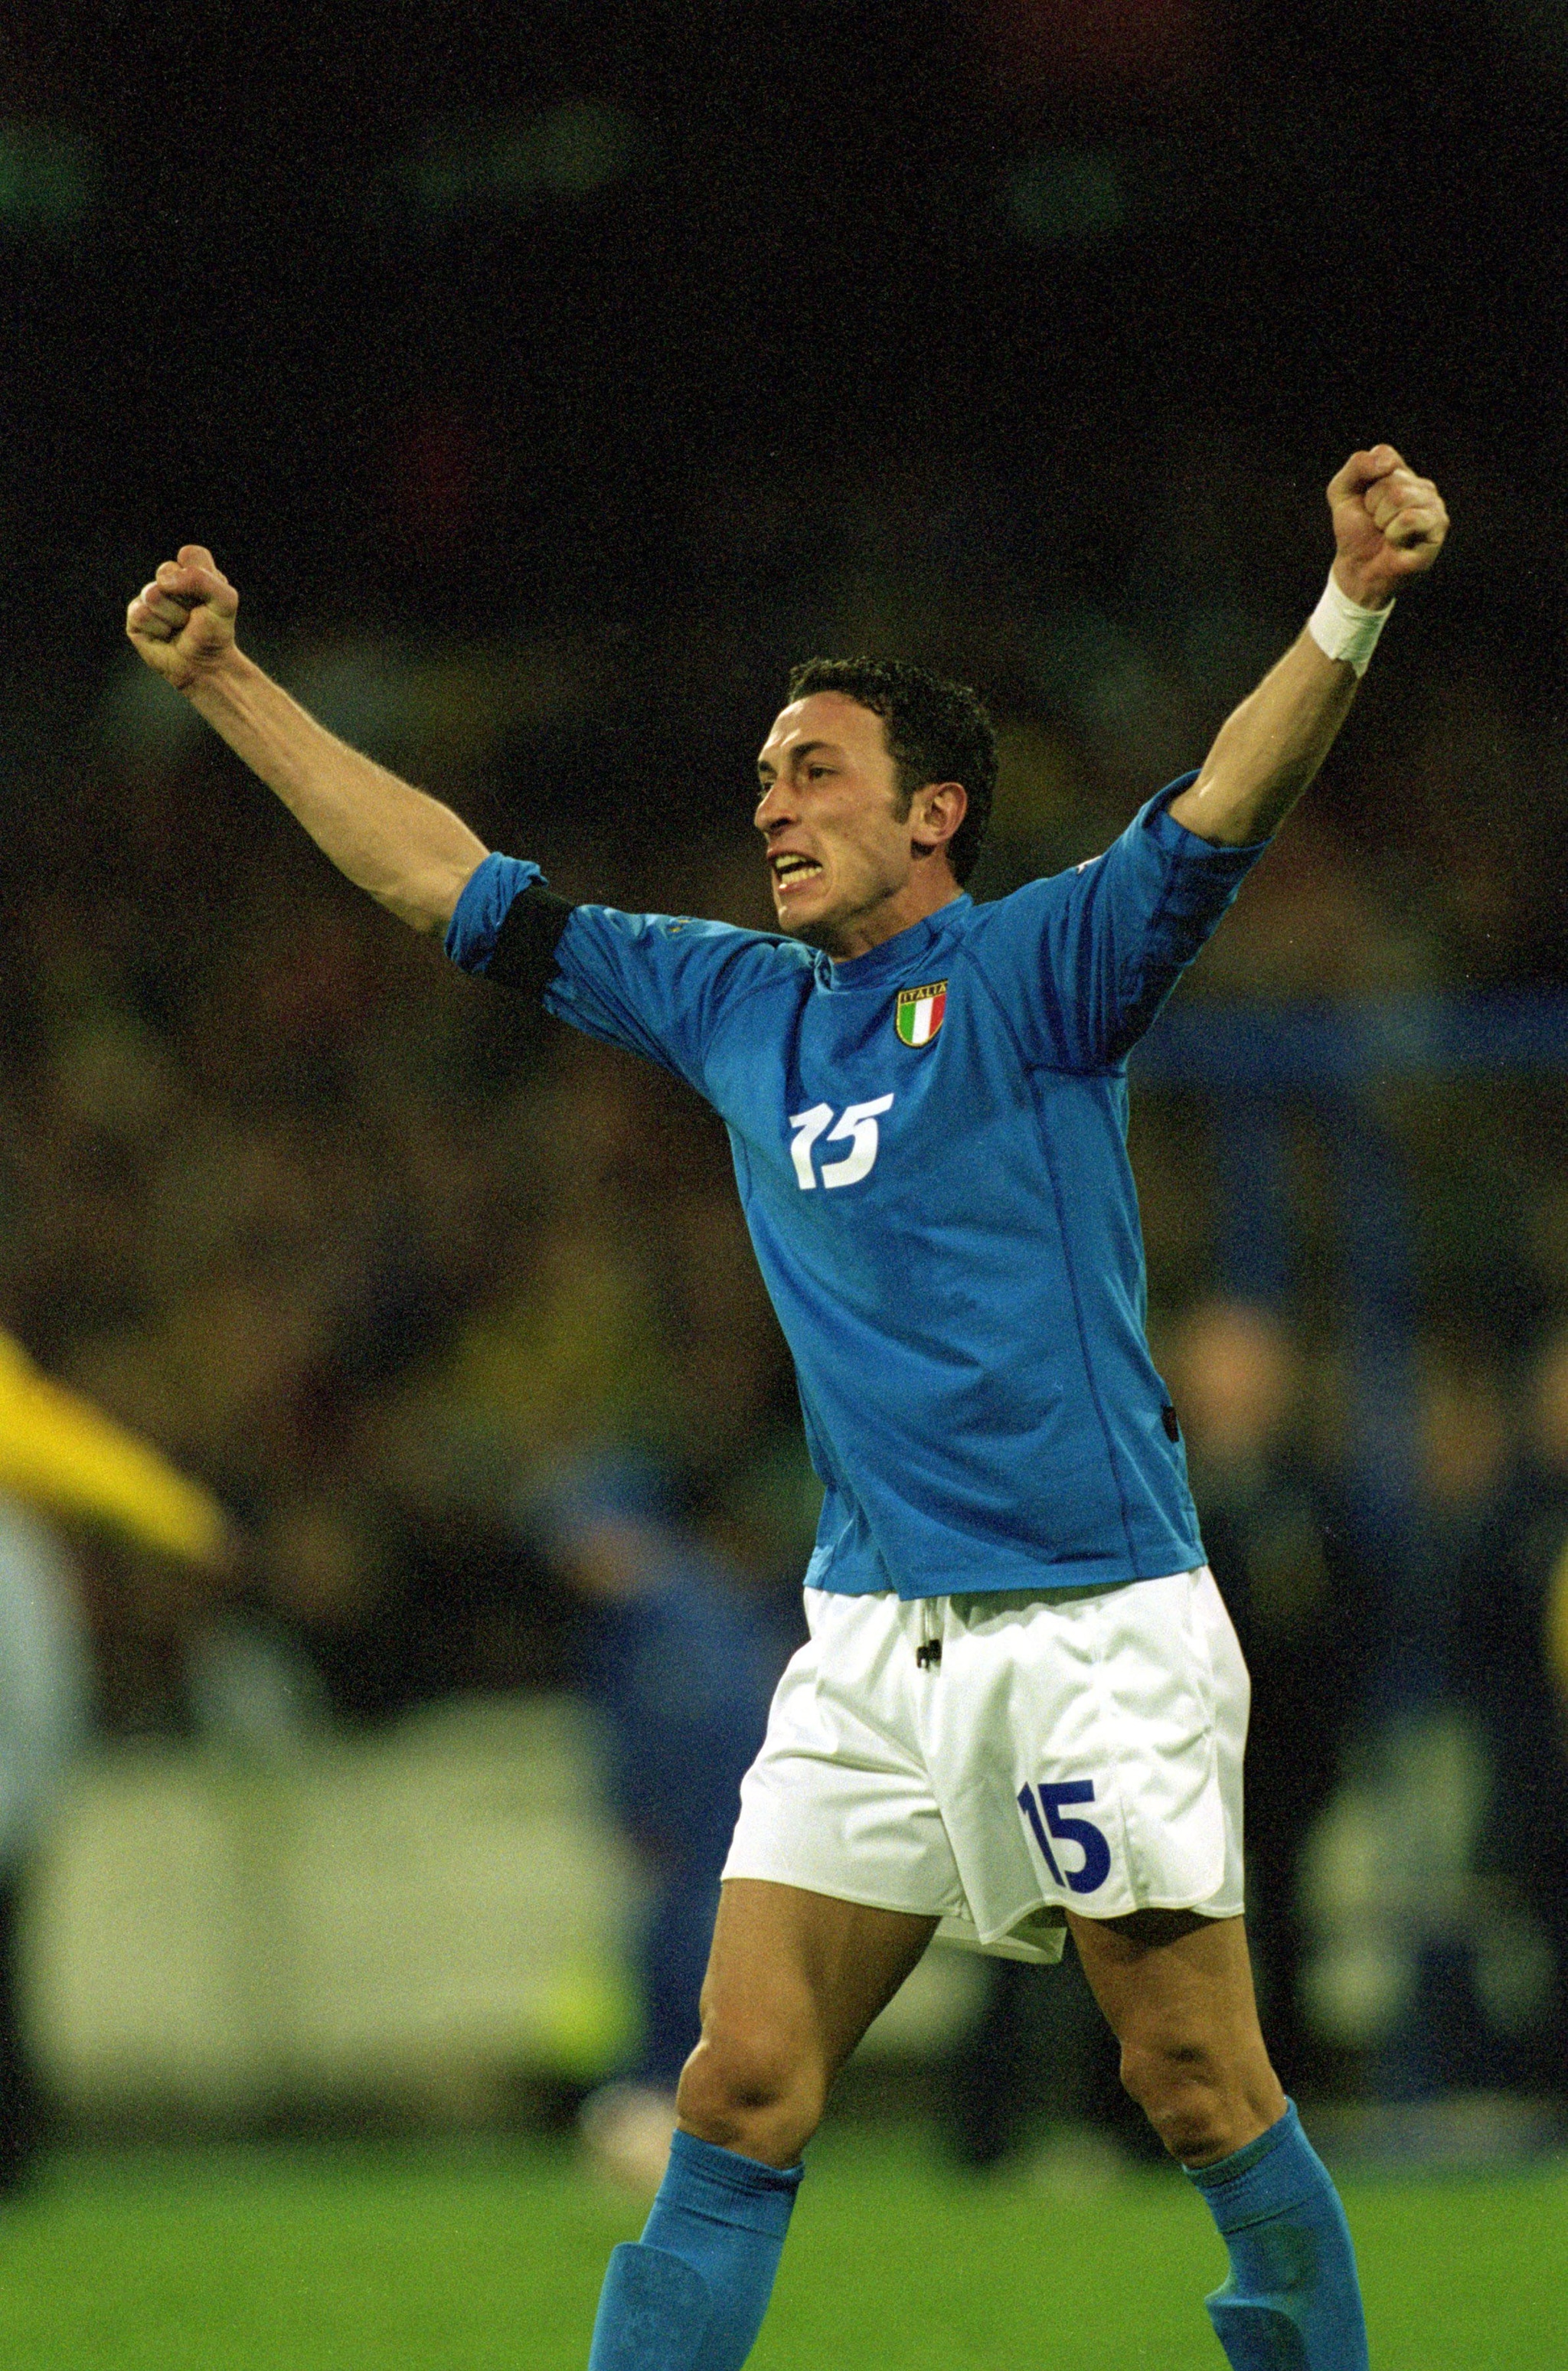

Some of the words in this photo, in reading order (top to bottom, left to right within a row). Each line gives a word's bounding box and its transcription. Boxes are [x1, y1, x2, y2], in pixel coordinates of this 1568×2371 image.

[903, 982, 946, 1001] ITALIA
[789, 1093, 894, 1190] 15
[1017, 1779, 1111, 1893] 15
